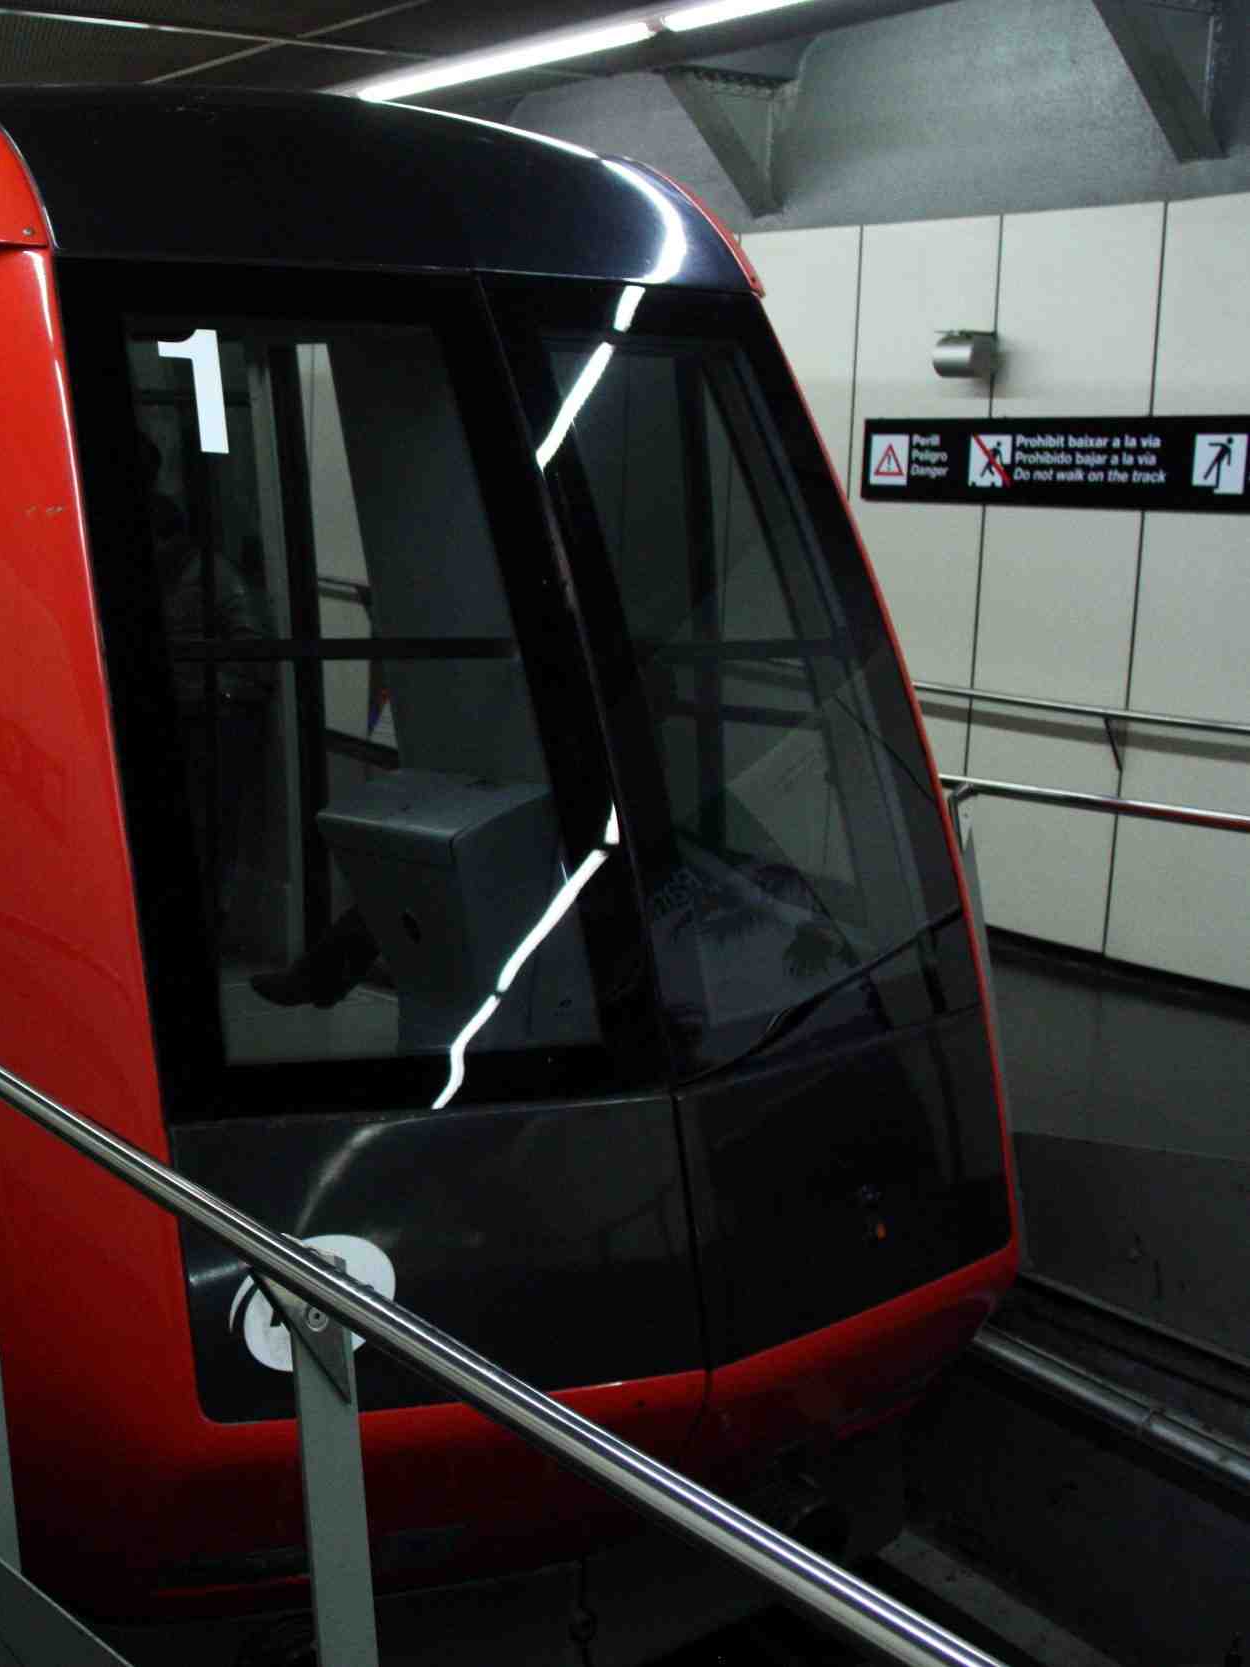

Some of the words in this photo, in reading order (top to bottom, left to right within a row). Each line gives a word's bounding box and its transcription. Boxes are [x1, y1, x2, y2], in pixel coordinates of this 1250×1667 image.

[157, 328, 230, 454] 1
[1015, 434, 1065, 447] Prohibit
[1068, 434, 1109, 447] baixar
[1112, 436, 1120, 447] a
[1124, 434, 1137, 447] la
[911, 449, 948, 465] Peligro
[1014, 451, 1072, 464] Prohibido
[1075, 451, 1107, 466] bajar
[1110, 454, 1119, 465] a
[1122, 452, 1134, 465] la
[910, 464, 948, 479] Danger
[1013, 467, 1030, 481] Do
[1032, 468, 1054, 481] not
[1056, 467, 1084, 481] walk
[1087, 470, 1104, 481] on
[1107, 468, 1129, 482] the
[1132, 467, 1167, 482] track
